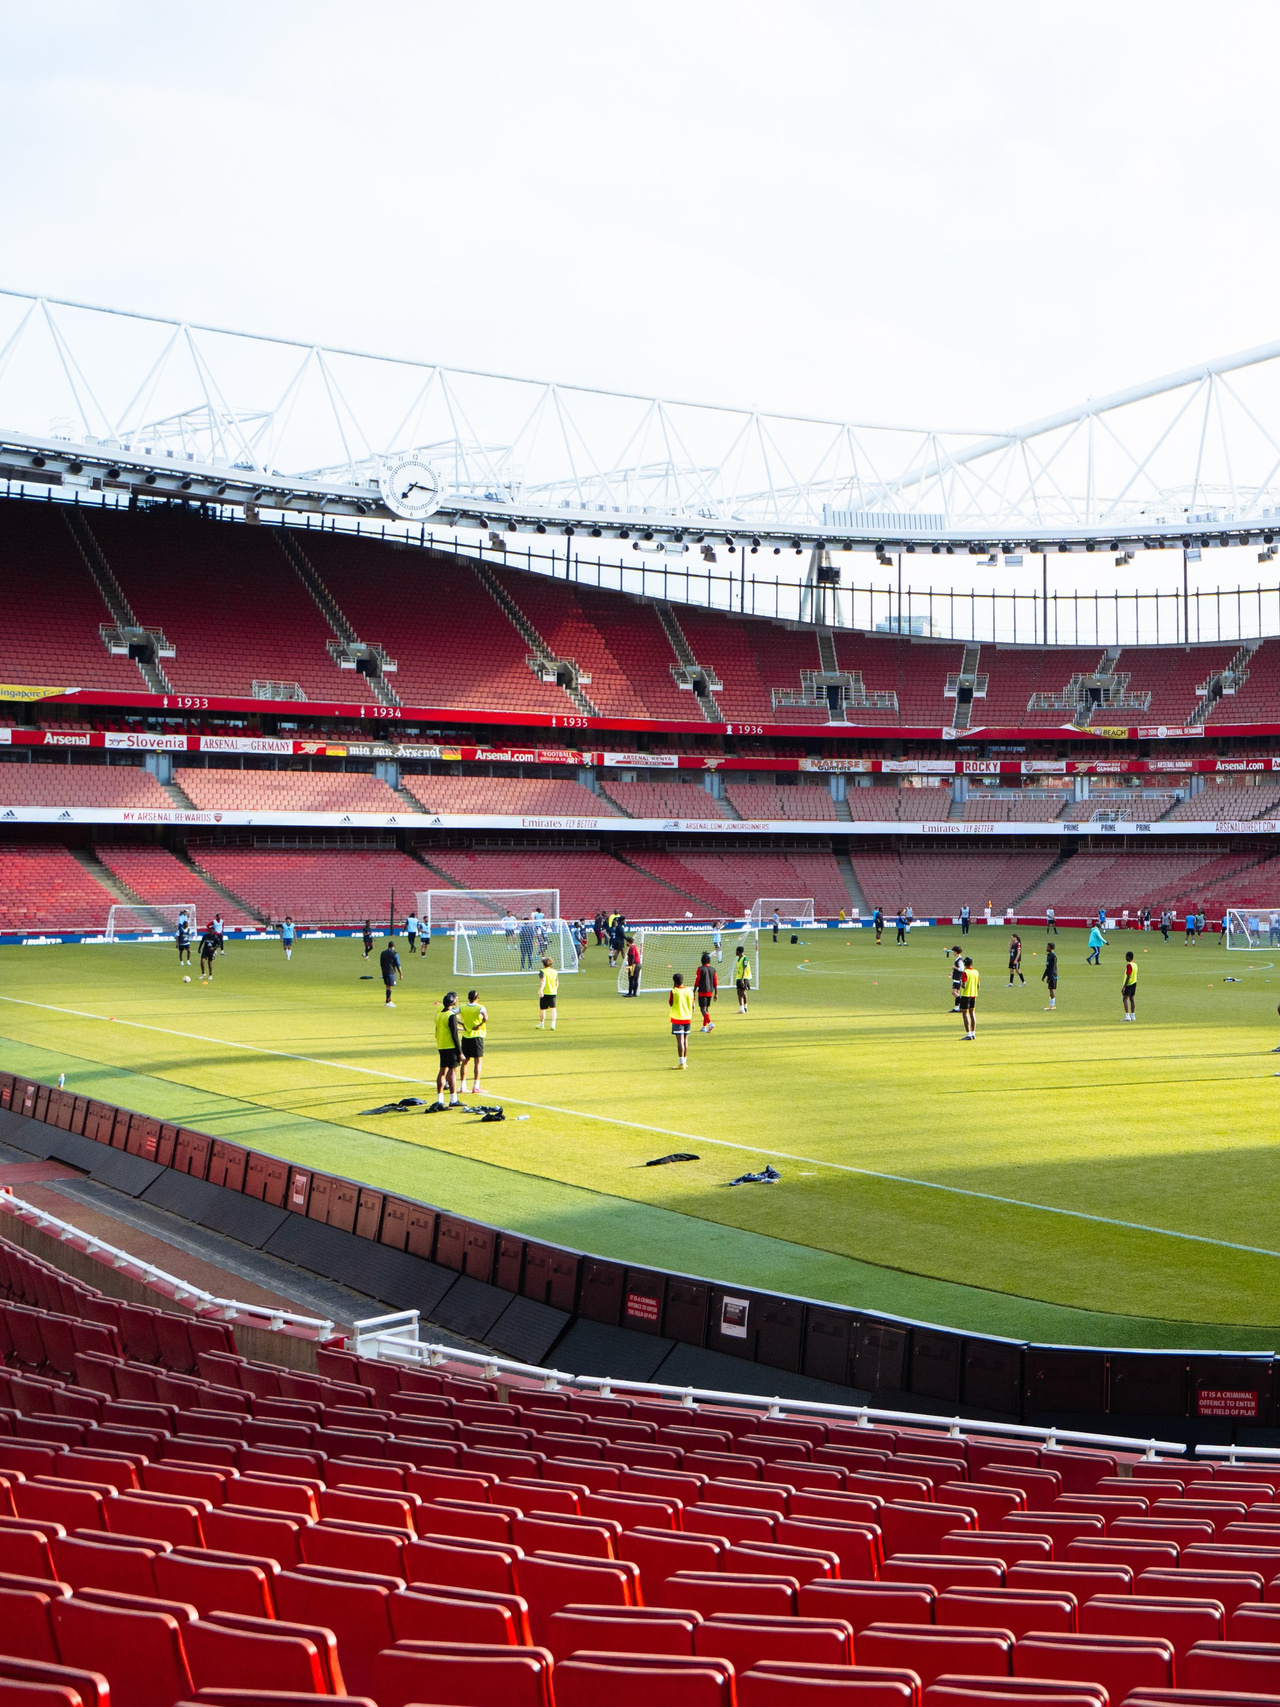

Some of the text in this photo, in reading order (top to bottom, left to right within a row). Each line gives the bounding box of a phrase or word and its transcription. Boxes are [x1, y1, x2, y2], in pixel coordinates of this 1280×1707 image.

[176, 697, 209, 708] 1933
[372, 707, 402, 718] 1934
[562, 717, 588, 728] 1935
[738, 726, 764, 734] 1936
[44, 733, 90, 746] Arsenal
[126, 736, 184, 748] Slovenia
[203, 738, 291, 753] ARSENAL GERMANY
[475, 750, 534, 762] Arsenal.com
[810, 760, 860, 768] MALTESE
[964, 762, 999, 772] ROCKY
[1216, 761, 1264, 771] Arsenal.com
[123, 812, 212, 822] MY ARSENAL REWARDS
[522, 818, 598, 828] Emirates FLY BETTER
[922, 824, 994, 832] Emirates FLY BETTER
[1215, 822, 1276, 833] ARSENALDIRECT.COM
